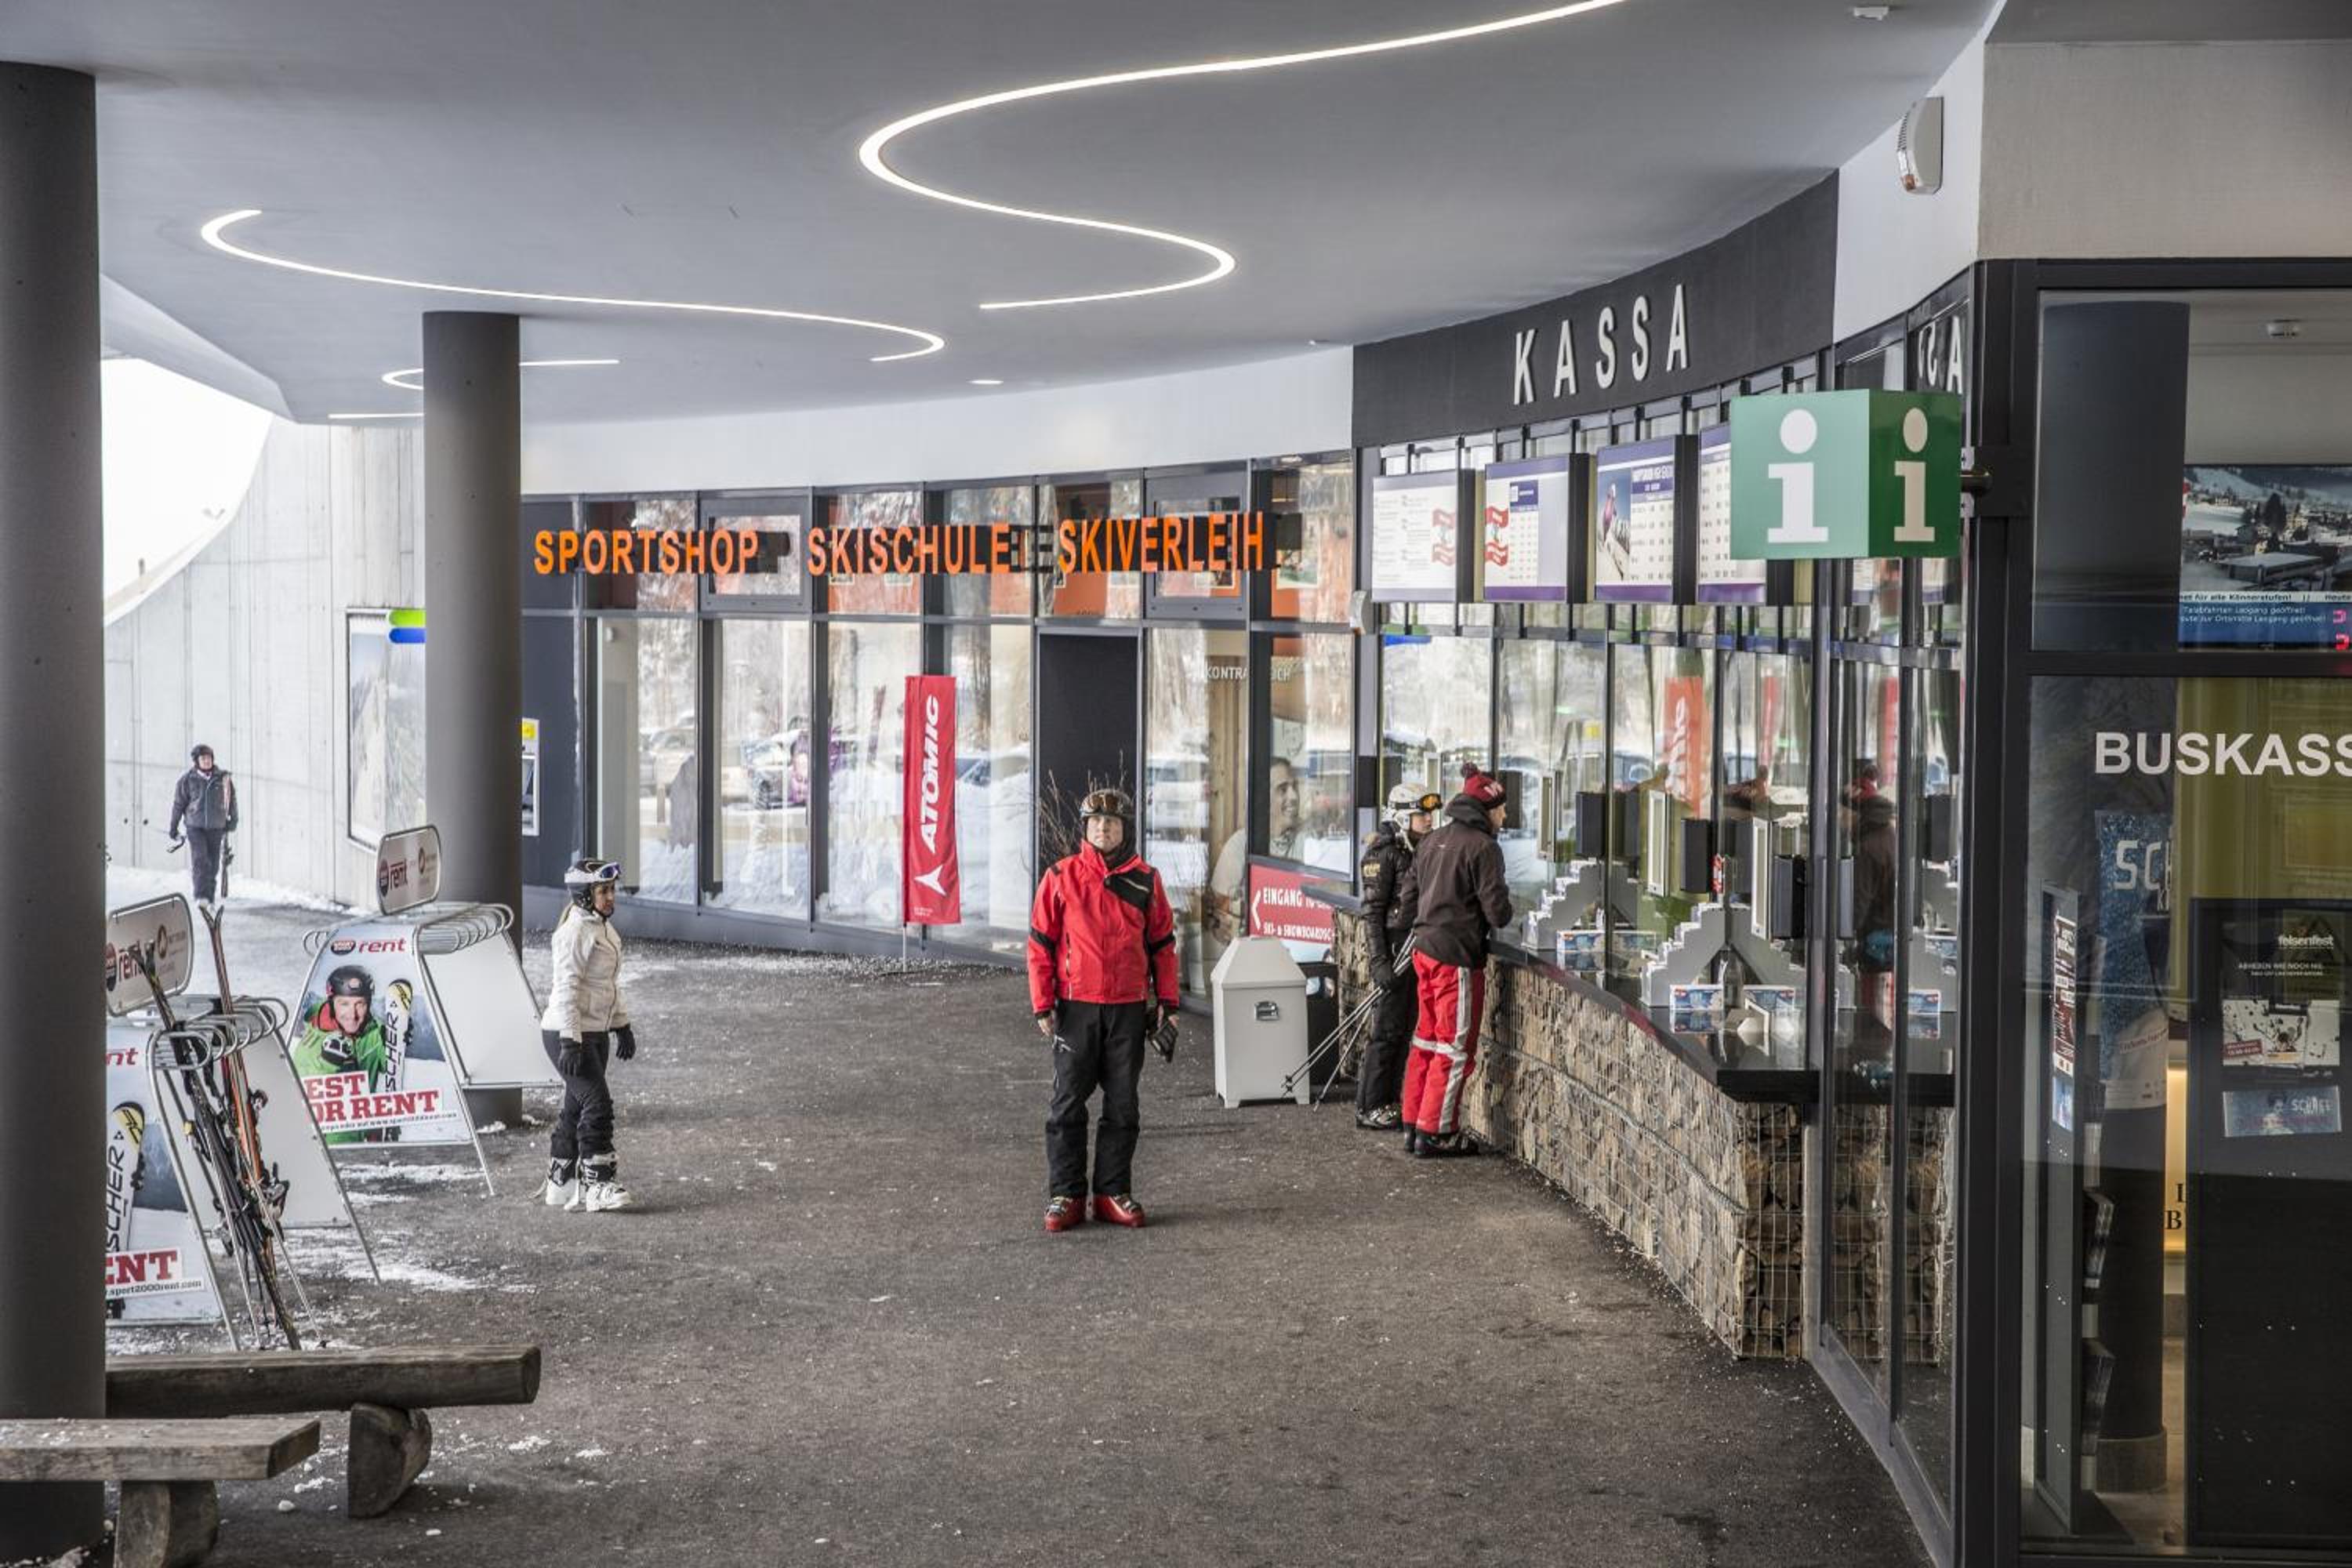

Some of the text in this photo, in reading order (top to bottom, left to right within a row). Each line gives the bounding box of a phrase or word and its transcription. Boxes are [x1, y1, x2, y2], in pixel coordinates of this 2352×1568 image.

[1514, 284, 1687, 405] KASSA
[1767, 408, 1829, 543] i
[1894, 407, 1935, 542] i
[534, 511, 1263, 576] SPORTSHOP SKISCHULE SKIVERLEIH
[920, 695, 940, 855] ATOMIC
[1263, 887, 1302, 908] EINGANG
[358, 938, 407, 953] rent
[2278, 934, 2334, 946] felsenfest
[386, 1011, 399, 1093] SCHER
[350, 1090, 439, 1120] RENT
